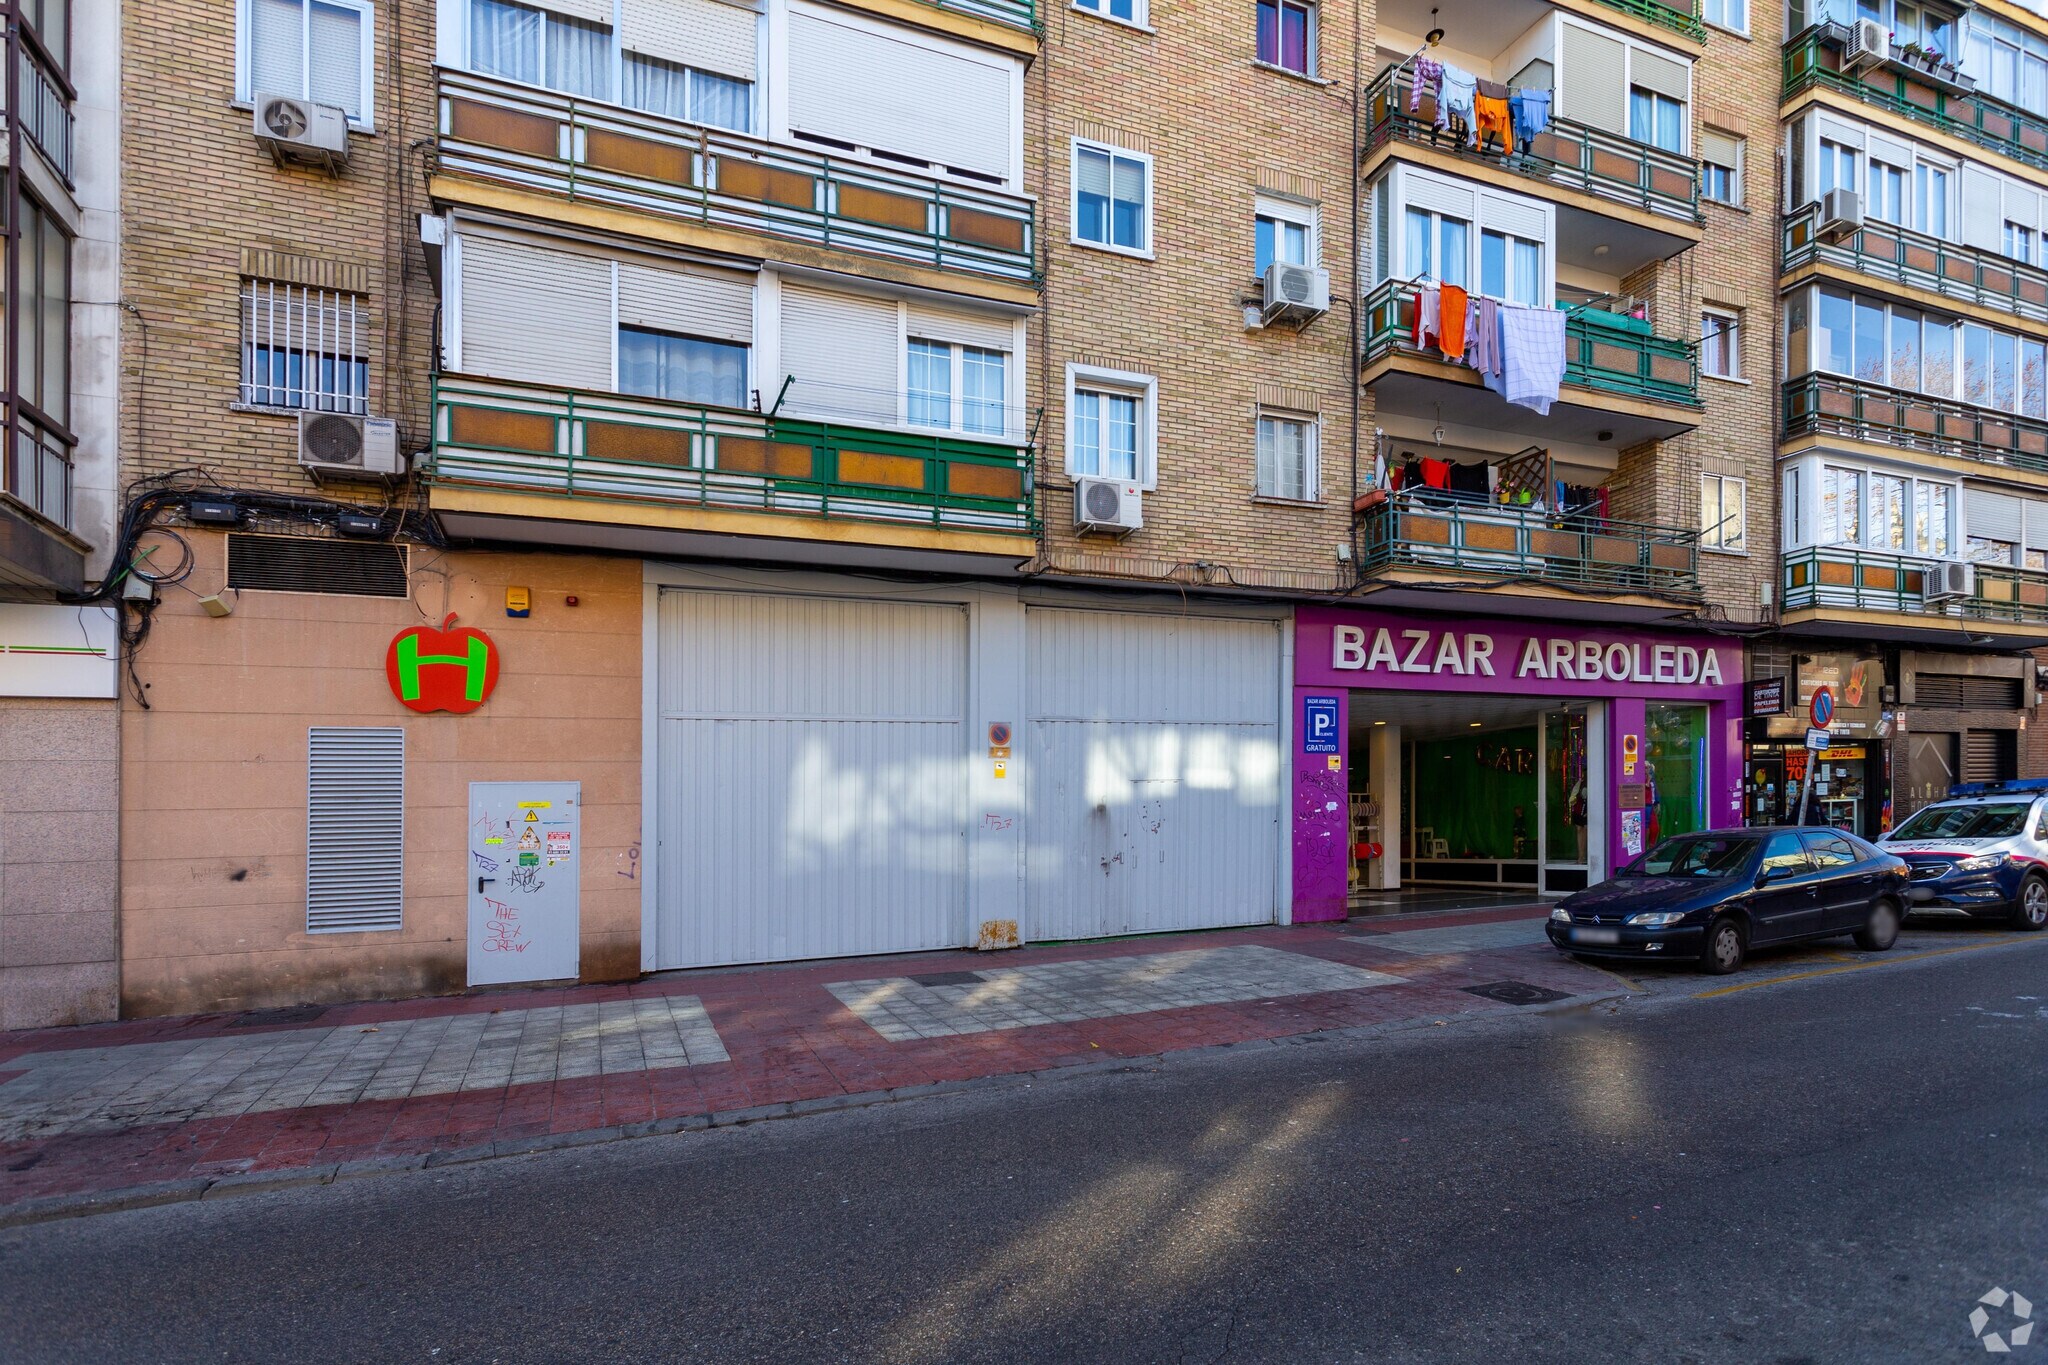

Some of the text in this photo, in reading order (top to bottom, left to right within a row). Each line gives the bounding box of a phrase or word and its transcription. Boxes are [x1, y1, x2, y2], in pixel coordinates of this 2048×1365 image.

[1332, 624, 1724, 686] BAZAR ARBOLEDA
[396, 633, 489, 703] H
[1315, 714, 1330, 736] P
[1306, 744, 1336, 752] GRATUITO
[1831, 750, 1853, 758] DHL
[1786, 758, 1812, 767] HAST
[486, 920, 522, 938] SEX
[482, 938, 531, 953] CREW
